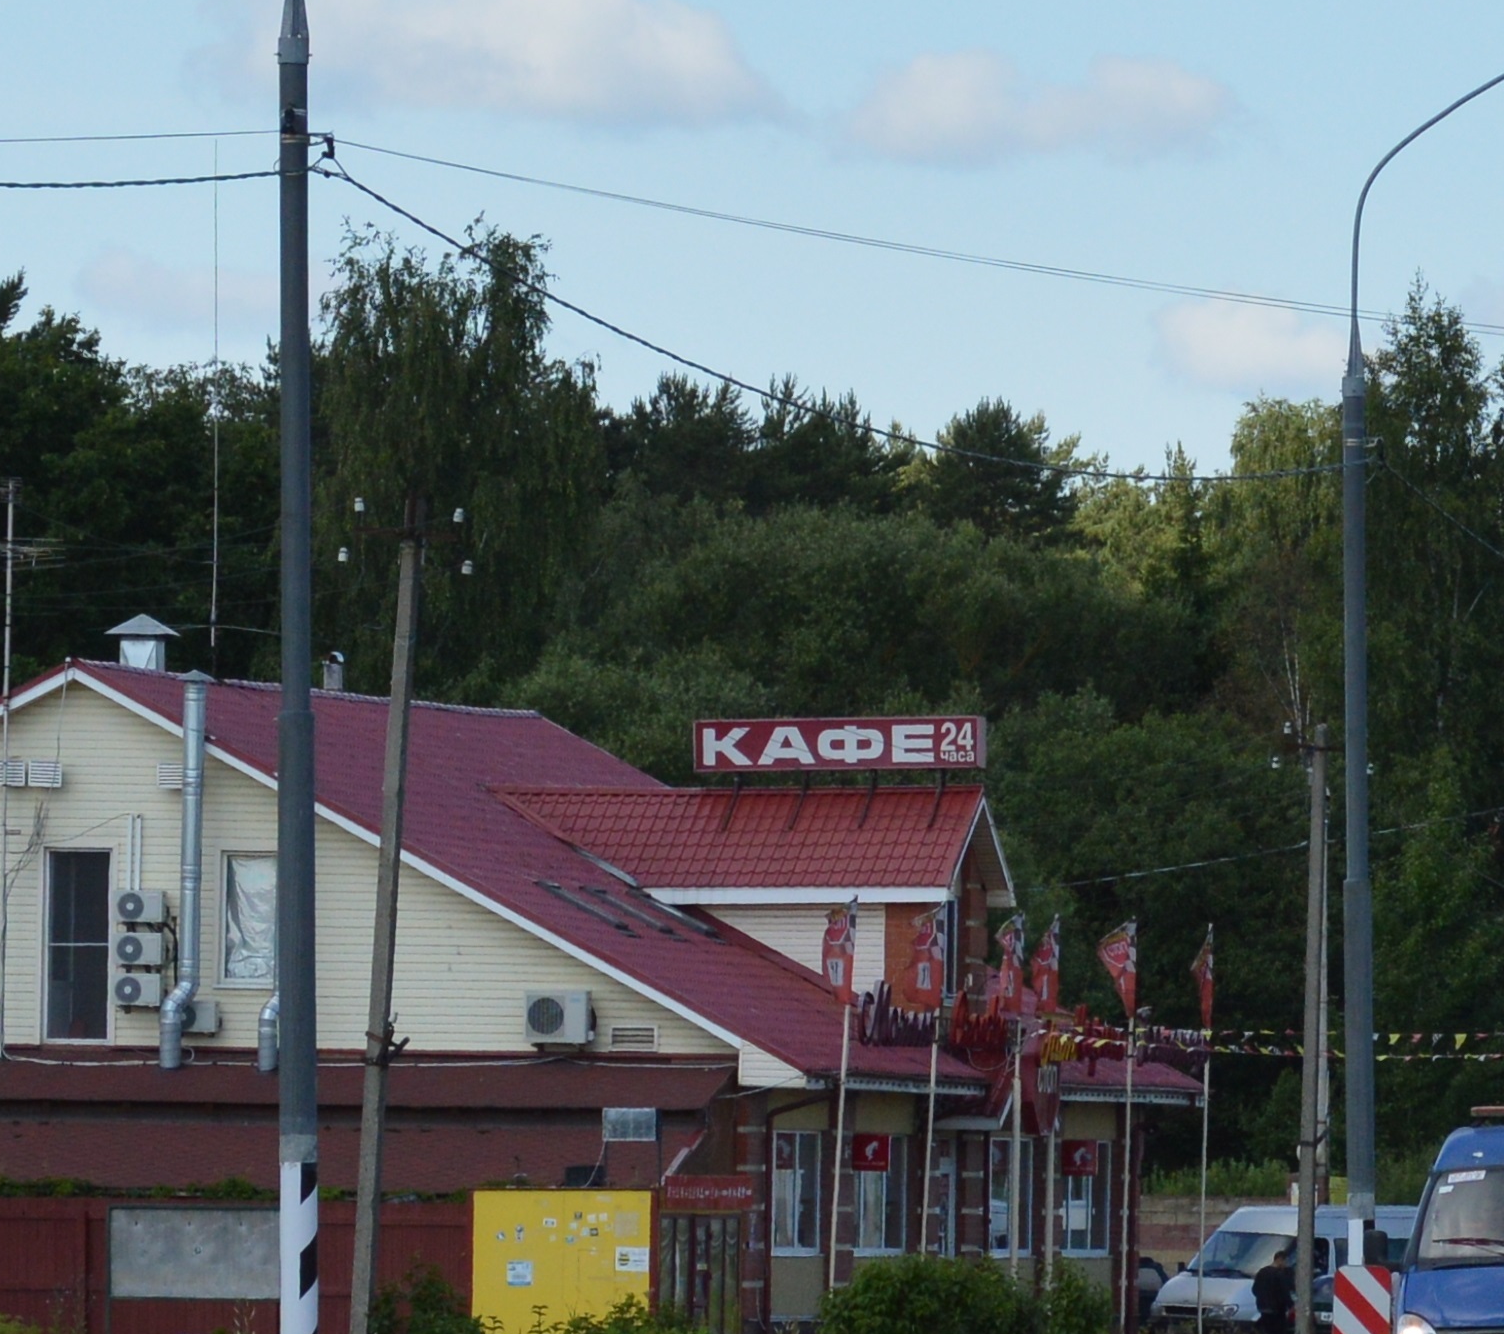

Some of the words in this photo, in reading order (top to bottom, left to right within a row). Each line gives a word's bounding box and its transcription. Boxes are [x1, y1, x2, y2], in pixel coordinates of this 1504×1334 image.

[702, 725, 935, 766] КАФЕ
[940, 722, 974, 751] 24
[940, 750, 975, 763] часа
